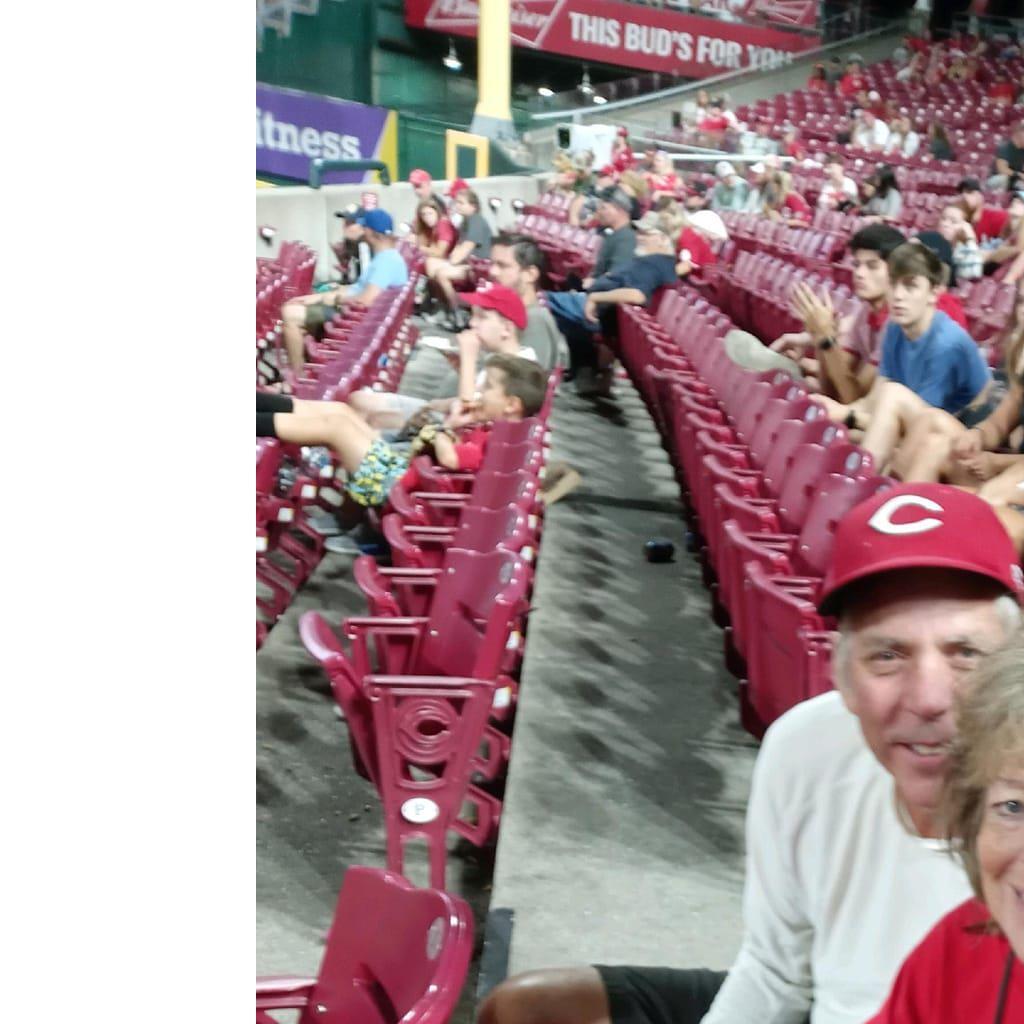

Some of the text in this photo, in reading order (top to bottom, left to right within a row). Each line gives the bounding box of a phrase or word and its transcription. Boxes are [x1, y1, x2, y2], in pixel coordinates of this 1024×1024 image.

[568, 11, 620, 48] THIS
[624, 22, 693, 61] BUD'S
[696, 35, 743, 68] FOR
[868, 494, 944, 535] C
